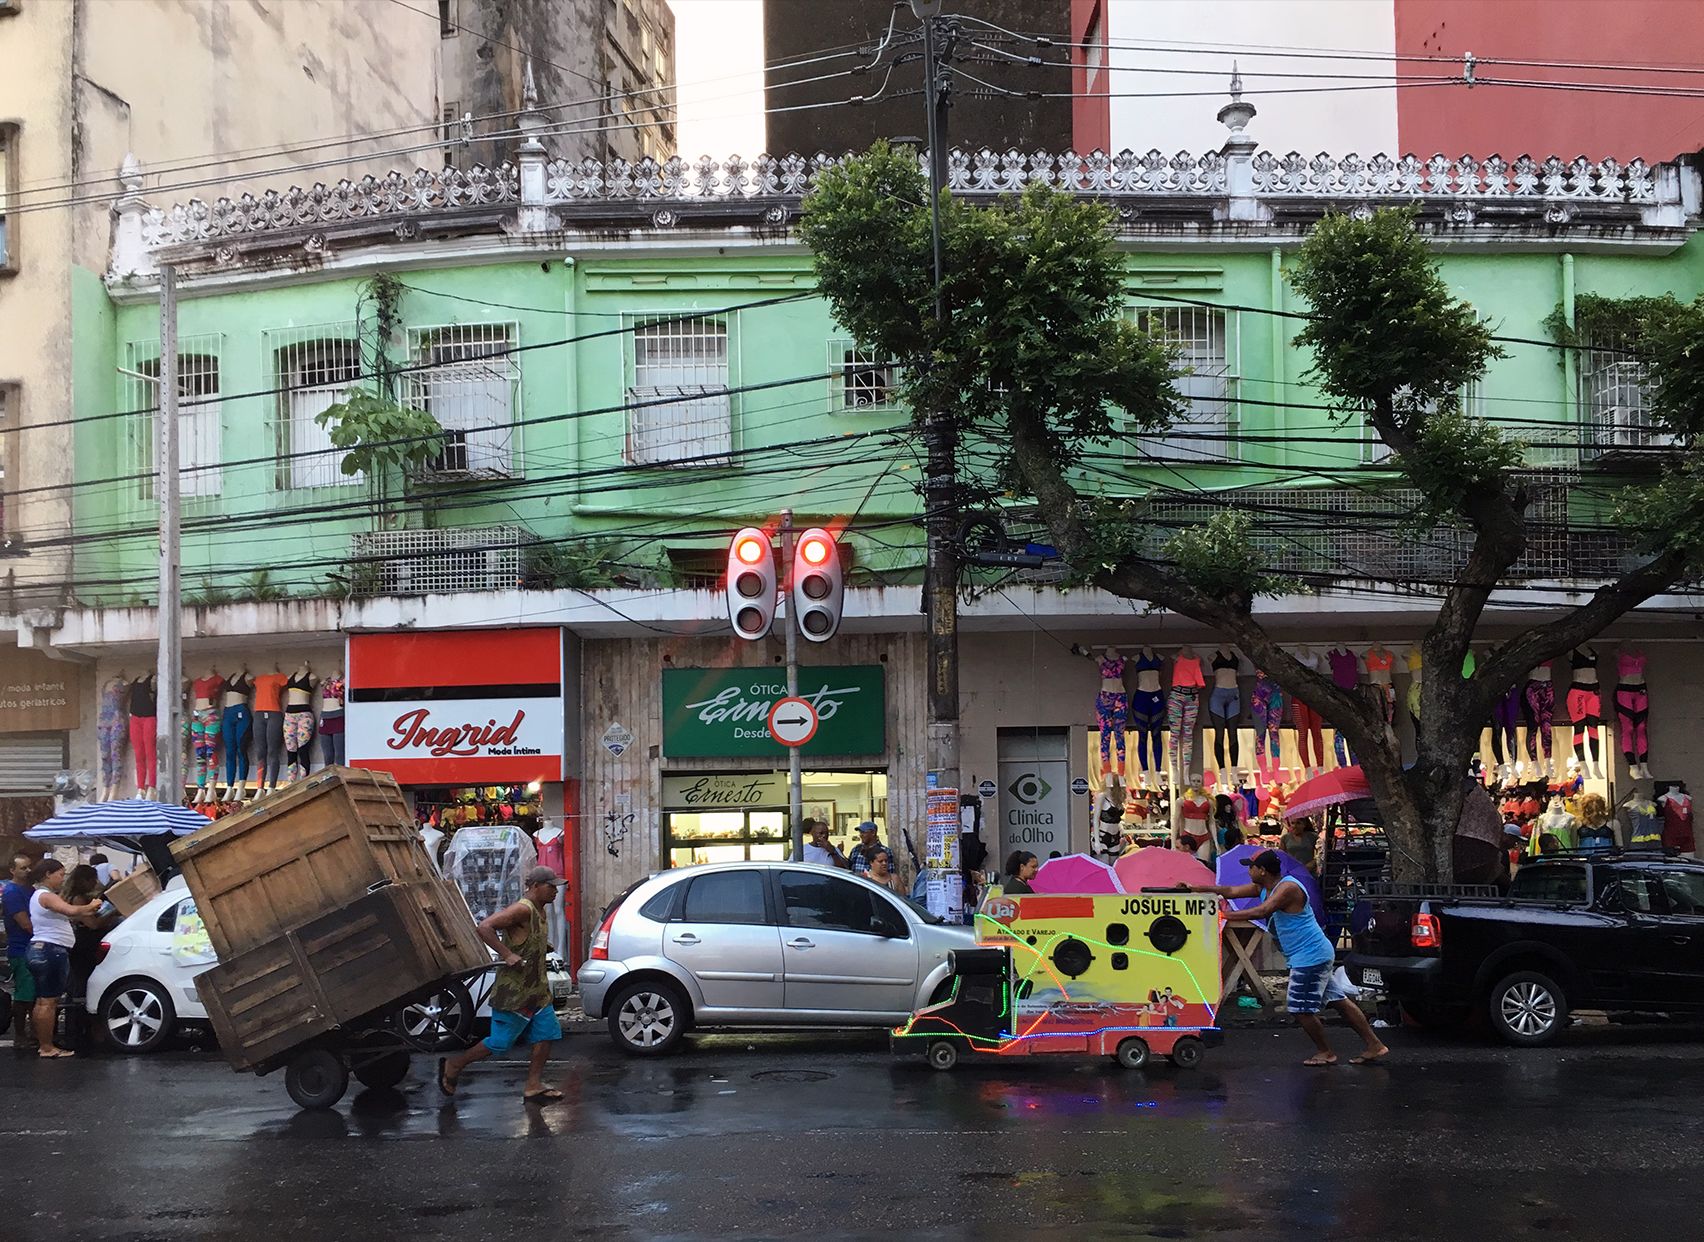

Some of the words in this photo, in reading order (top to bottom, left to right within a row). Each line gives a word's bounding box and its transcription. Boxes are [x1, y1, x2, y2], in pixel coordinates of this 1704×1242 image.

[7, 684, 31, 692] moda
[749, 683, 789, 695] ÓTICA
[685, 684, 861, 725] Ernto
[386, 708, 526, 757] Ingrid
[733, 727, 772, 739] Desde
[488, 747, 512, 756] Moda
[513, 745, 541, 755] Íntima
[679, 777, 775, 804] Ernesto
[714, 780, 736, 788] ÓTICA
[1008, 809, 1054, 825] Clínica
[1009, 833, 1021, 844] do
[1022, 827, 1054, 843] Olho
[987, 903, 1016, 919] Uai
[1120, 899, 1181, 915] JOSUEL
[1185, 899, 1217, 916] MP3
